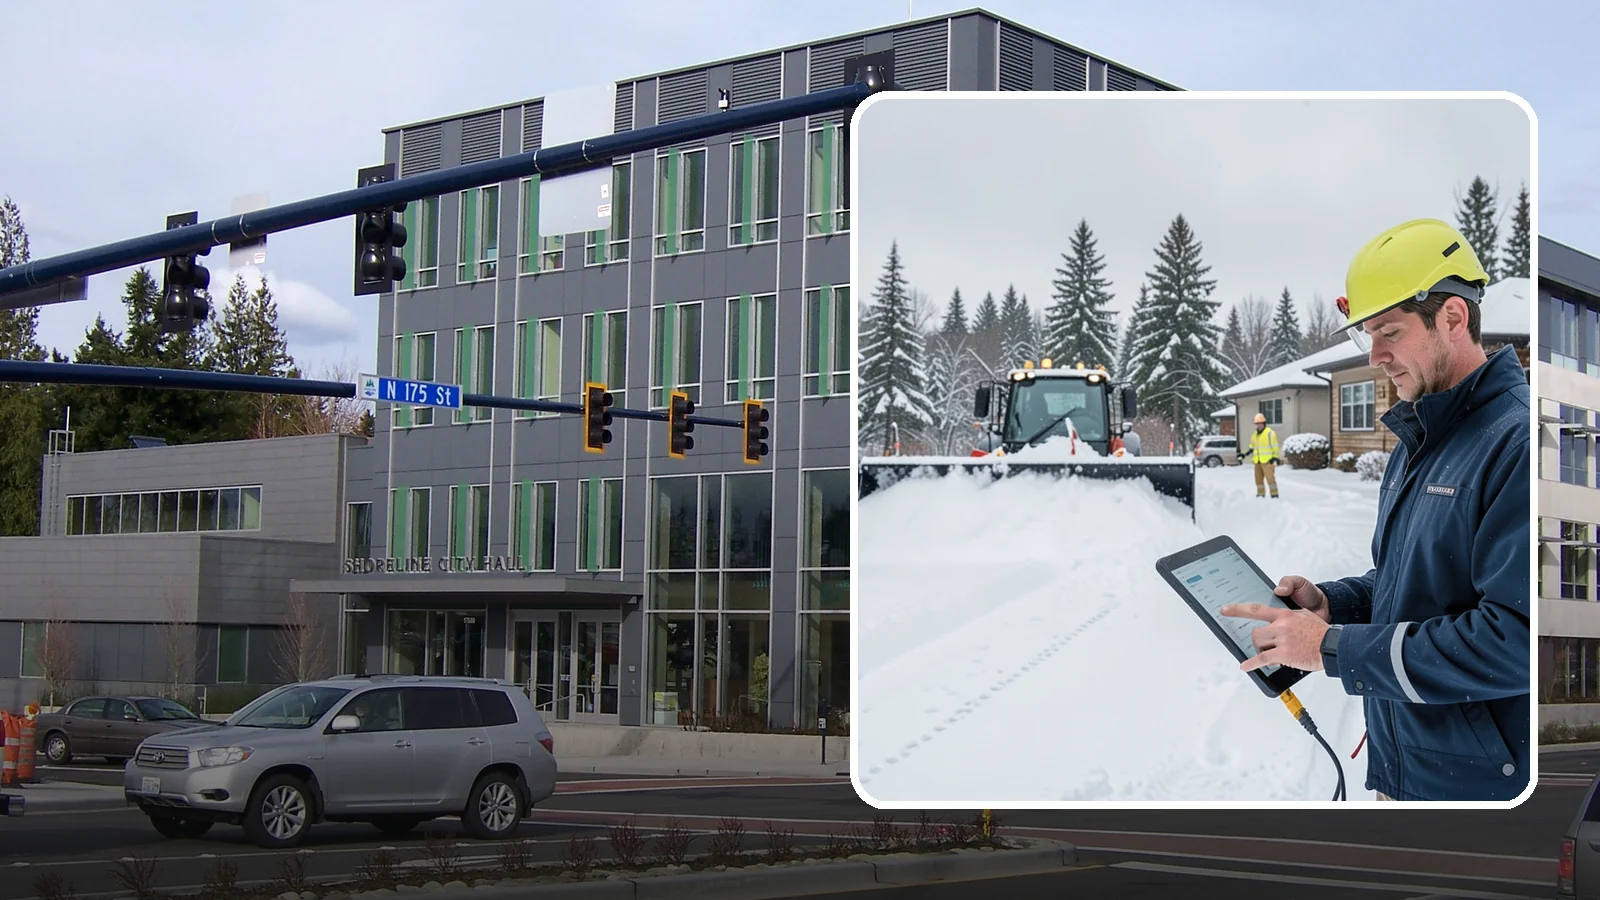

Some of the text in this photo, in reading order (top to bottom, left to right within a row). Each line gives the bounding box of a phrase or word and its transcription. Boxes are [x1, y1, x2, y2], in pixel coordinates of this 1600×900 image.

[387, 381, 451, 405] N 175 St
[344, 555, 526, 574] SHORELINE CITY HALL
